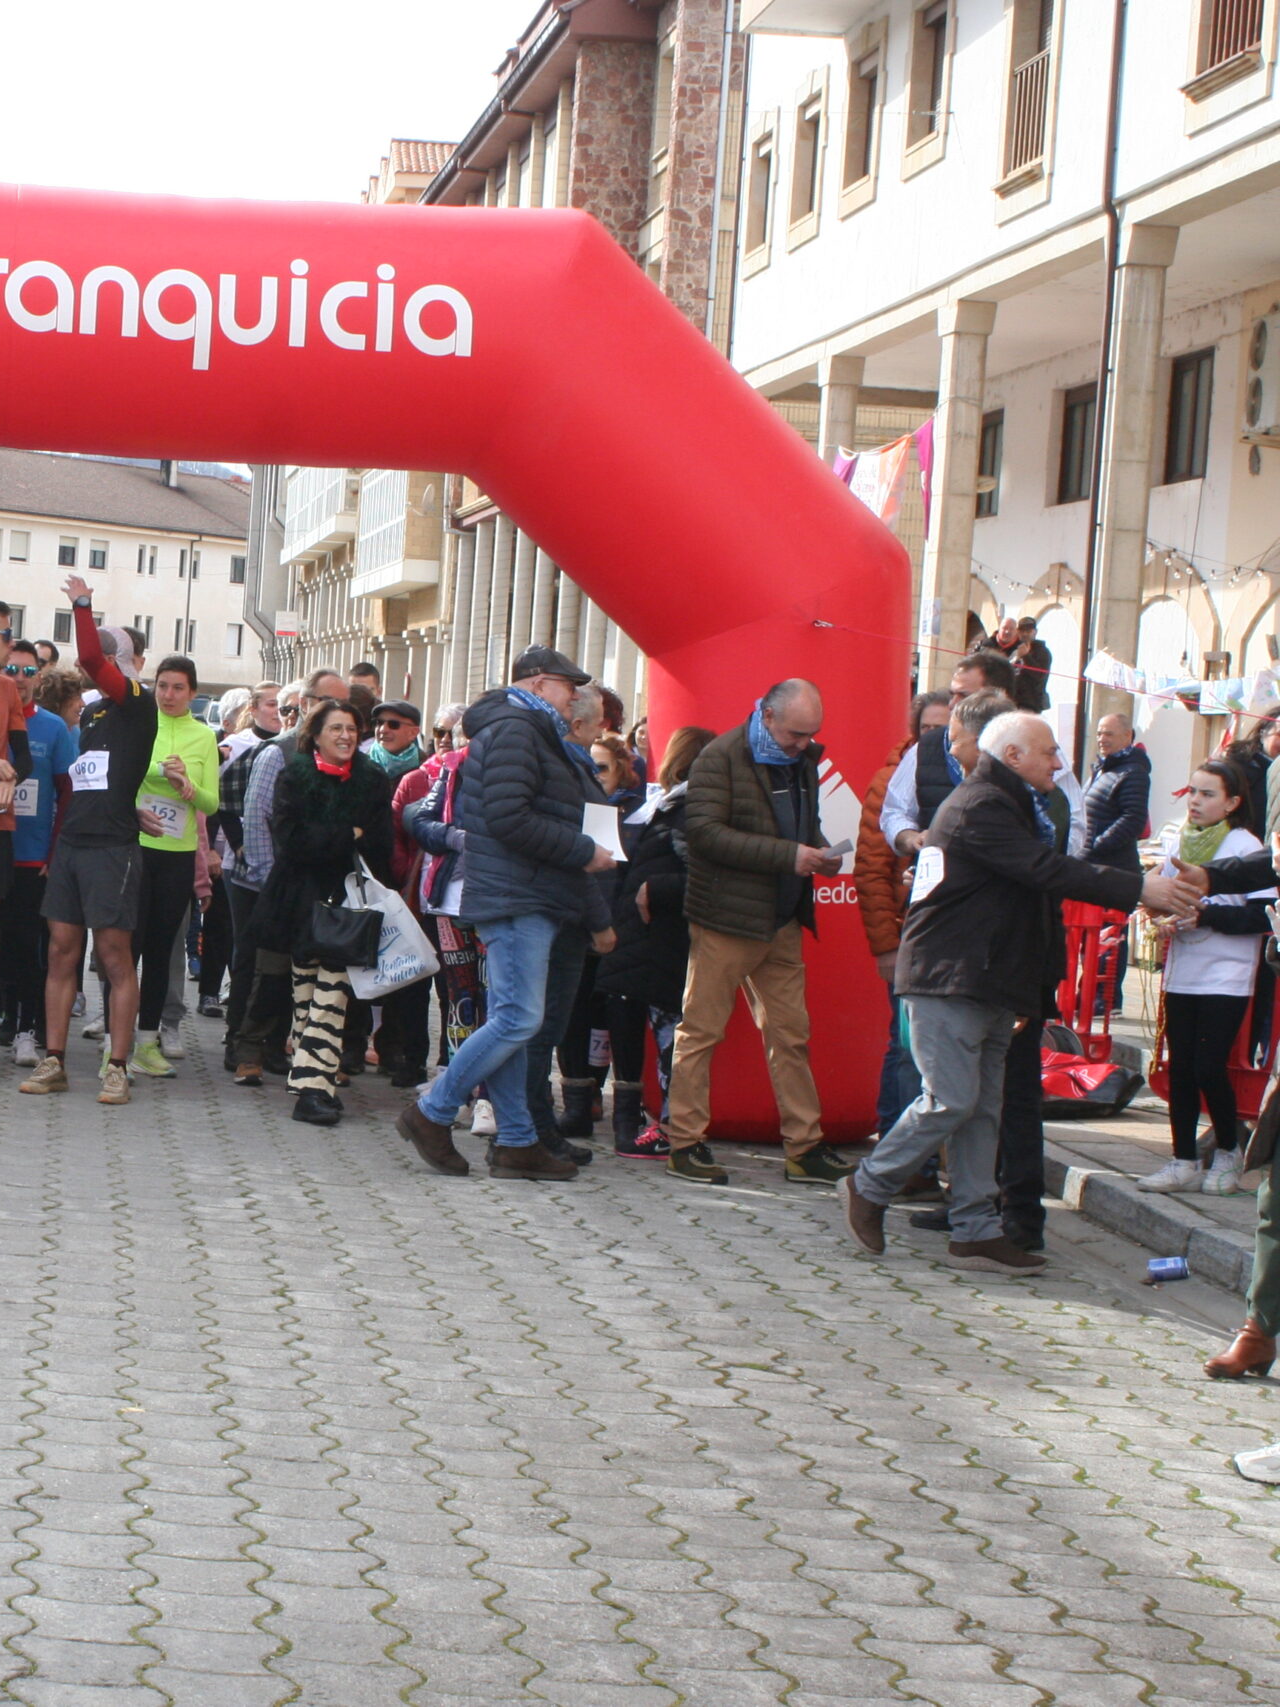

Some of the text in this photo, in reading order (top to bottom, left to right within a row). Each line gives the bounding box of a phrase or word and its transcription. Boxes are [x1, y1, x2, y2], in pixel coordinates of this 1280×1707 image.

[74, 761, 96, 775] 080
[14, 789, 28, 801] 20
[918, 863, 930, 879] 21
